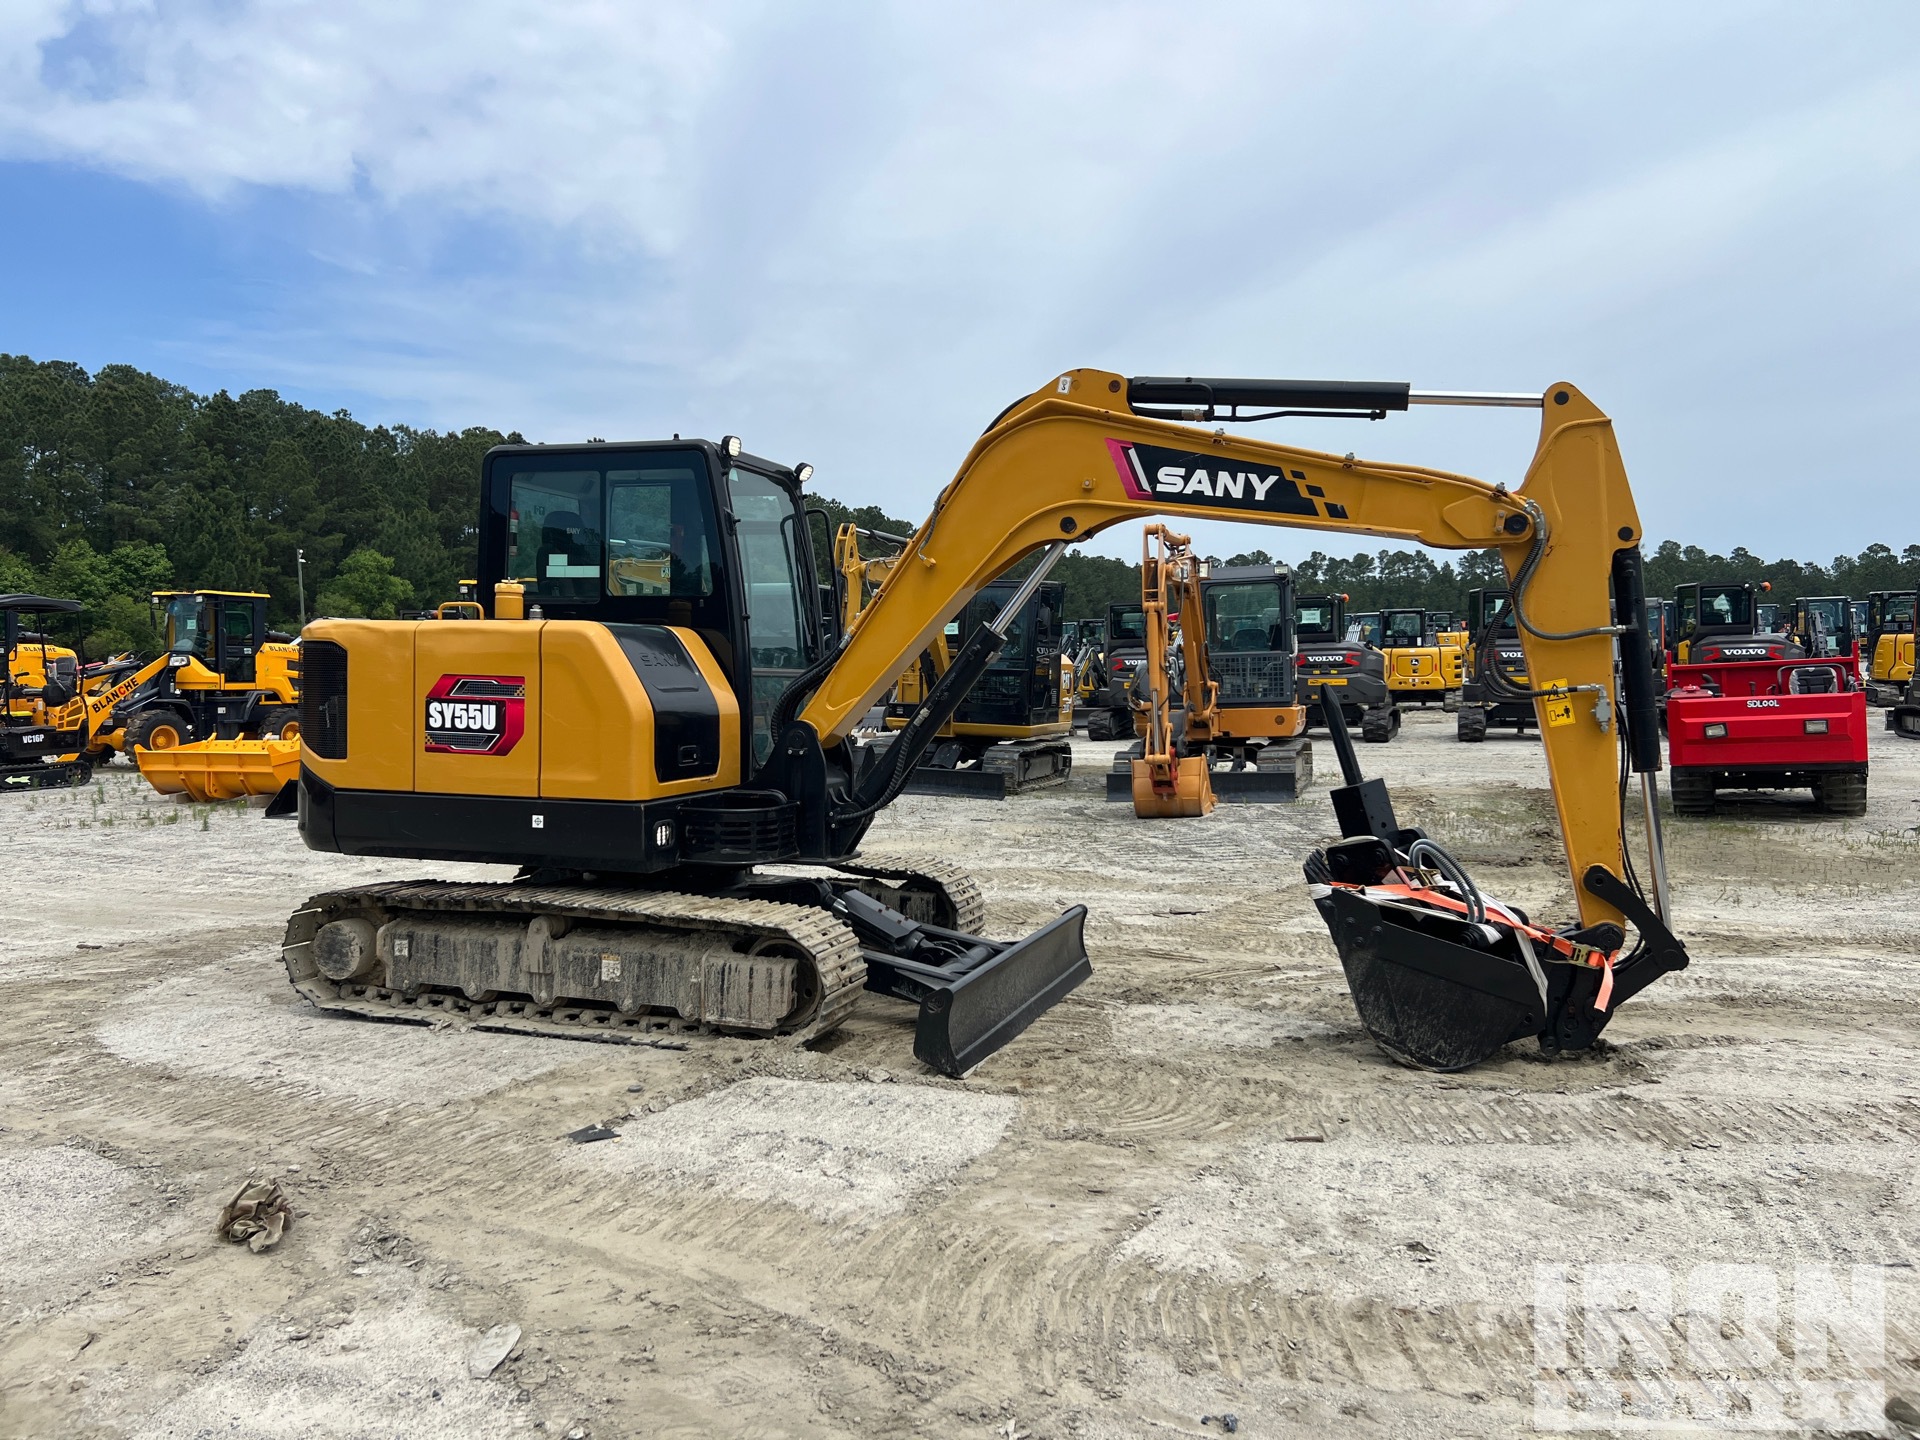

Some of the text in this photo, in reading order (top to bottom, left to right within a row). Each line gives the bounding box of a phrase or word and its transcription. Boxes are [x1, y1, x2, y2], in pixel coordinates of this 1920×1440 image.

[1156, 466, 1279, 501] SANY
[639, 652, 681, 667] SANY
[1722, 648, 1766, 656] VOLVO
[92, 677, 139, 714] BLANCHE
[428, 700, 497, 731] SY55U
[22, 733, 45, 744] VC16P
